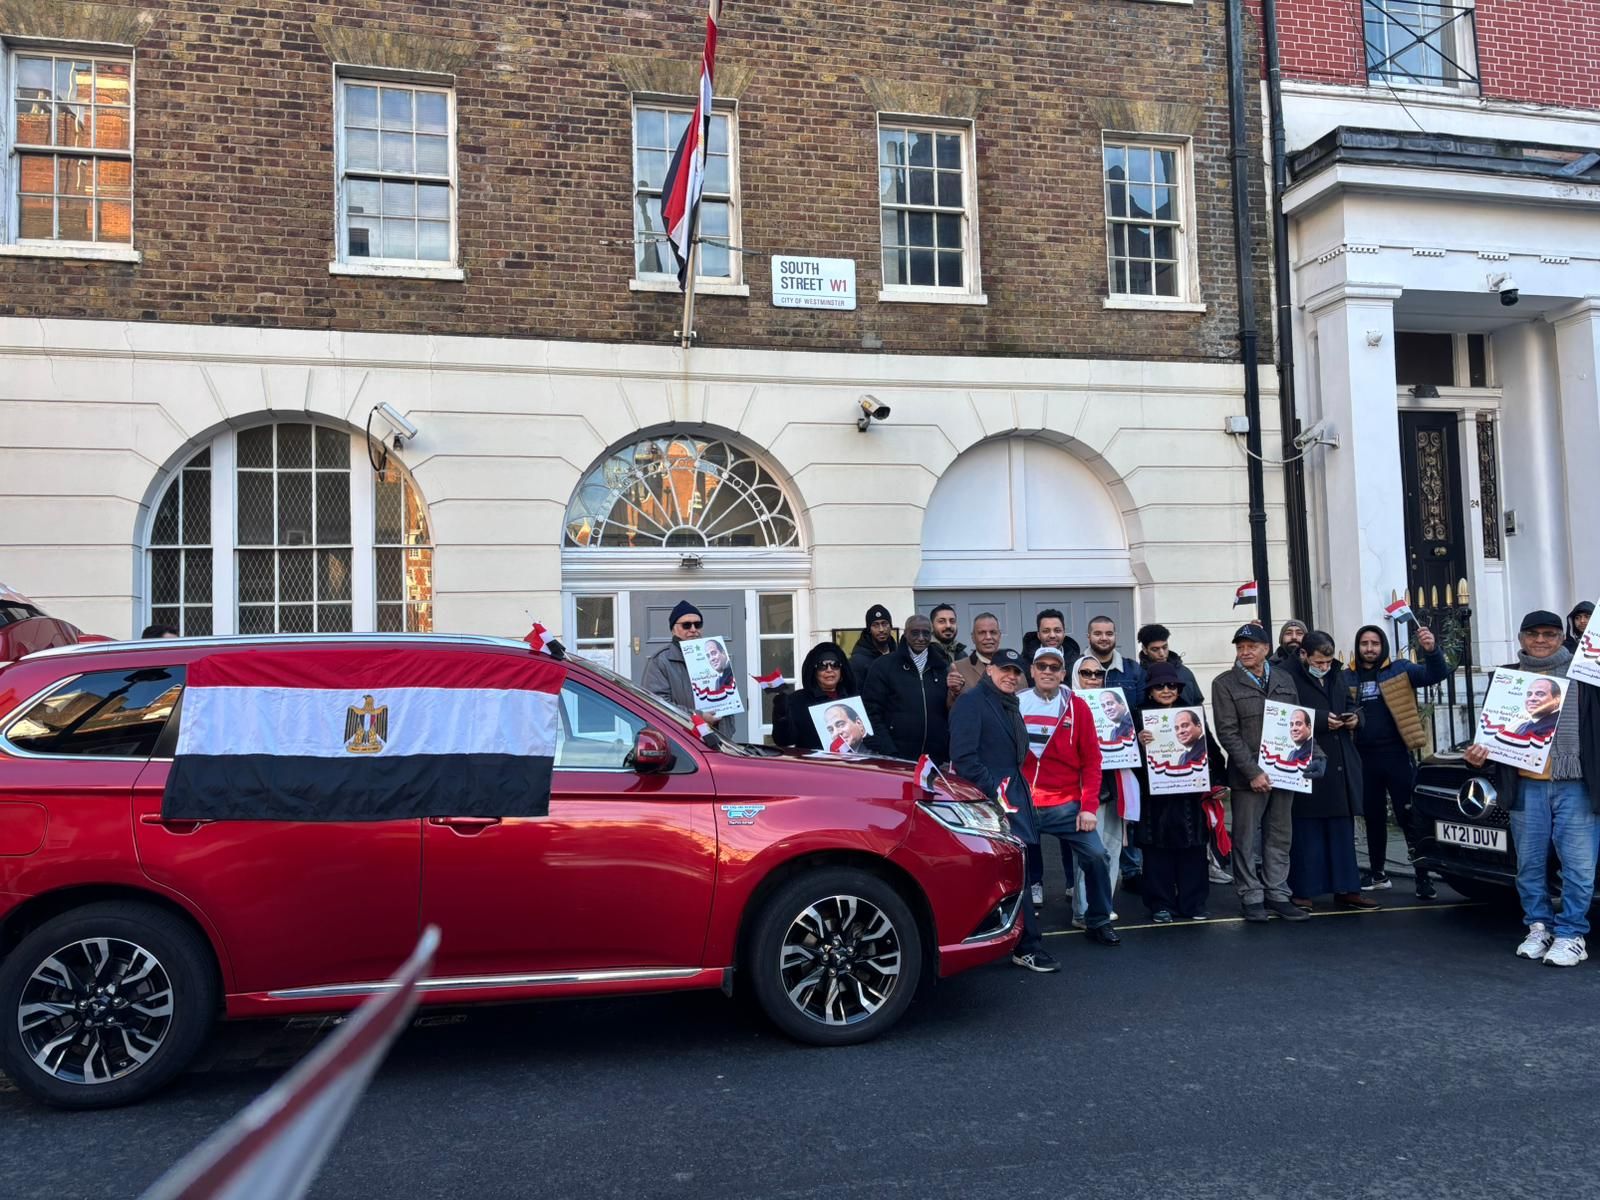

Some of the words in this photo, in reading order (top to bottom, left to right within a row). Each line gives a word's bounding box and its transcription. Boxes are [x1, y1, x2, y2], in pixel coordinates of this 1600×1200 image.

[780, 261, 819, 275] SOUTH
[780, 276, 823, 291] STREET
[830, 279, 847, 292] W1
[804, 298, 845, 306] WESTMINSTER
[1470, 500, 1480, 508] 24
[1443, 823, 1470, 843] KT21
[1472, 828, 1498, 847] DUV
